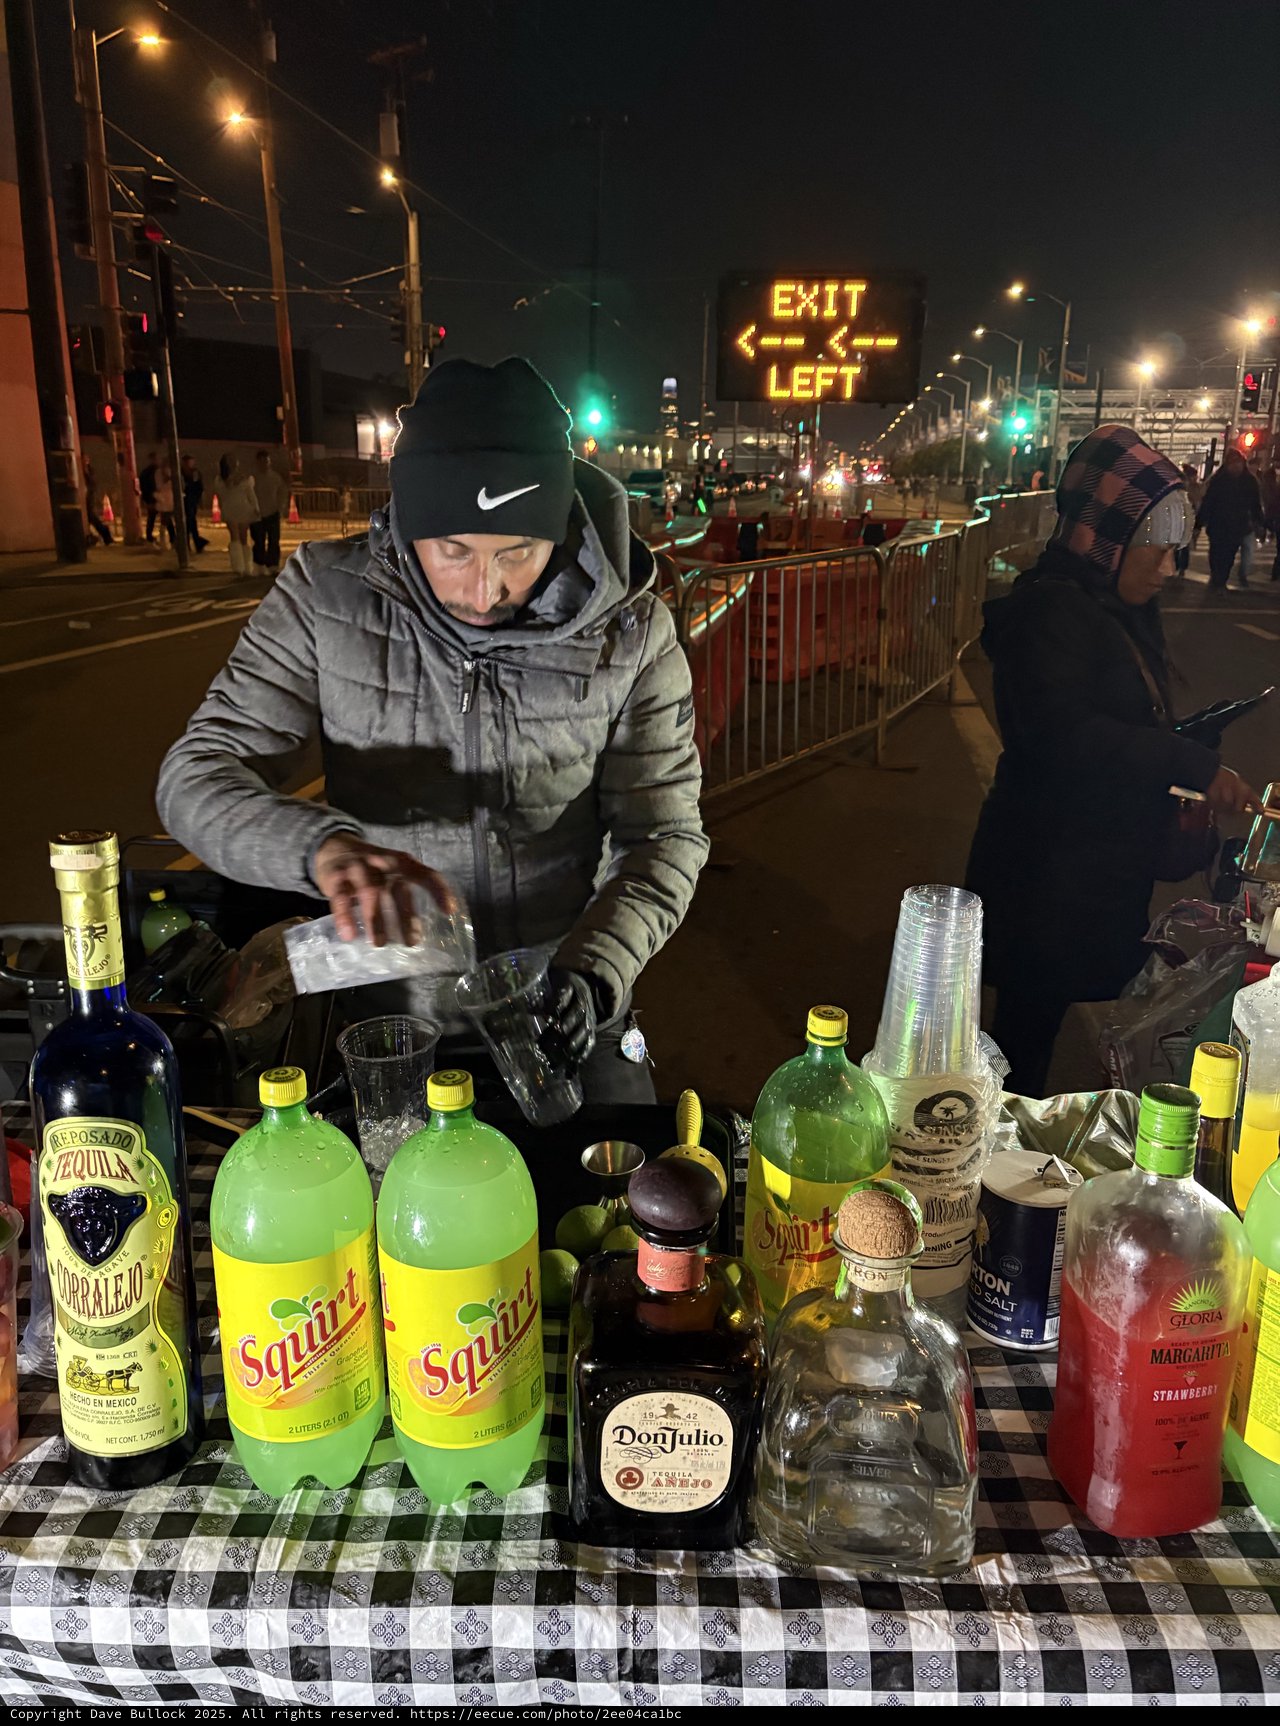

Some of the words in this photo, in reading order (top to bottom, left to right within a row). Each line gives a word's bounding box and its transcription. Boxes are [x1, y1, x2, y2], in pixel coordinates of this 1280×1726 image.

[773, 284, 866, 317] EXIT
[769, 365, 861, 399] LEFT
[53, 1130, 133, 1149] REPOSADO
[53, 1149, 139, 1185] TEQUILA
[758, 1206, 834, 1266] Squirt
[924, 1241, 952, 1251] RNING
[81, 1268, 93, 1278] DE
[98, 1250, 129, 1277] AGAVE
[57, 1258, 143, 1320] CORRALEJO
[972, 1262, 1011, 1296] RTON
[984, 1291, 1018, 1313] SALT
[1184, 1299, 1209, 1311] RANCHO
[240, 1267, 359, 1392] Squirt
[1170, 1311, 1223, 1328] GLORIA
[422, 1265, 535, 1397] Squirt
[303, 1358, 328, 1380] Thirst
[330, 1323, 361, 1357] Quencher
[1150, 1340, 1231, 1365] MARGARITA
[488, 1360, 510, 1382] Thirst
[70, 1391, 91, 1406] HECHO
[93, 1398, 103, 1407] EN
[106, 1397, 137, 1408] MEXICO
[1153, 1385, 1217, 1401] STRAWBERRY
[295, 1422, 322, 1434] LITERS
[323, 1417, 336, 1428] (2.1
[338, 1411, 349, 1421] QT)
[686, 1412, 698, 1420] 42
[118, 1435, 138, 1443] CONT.
[140, 1430, 157, 1441] 1,750
[157, 1426, 166, 1435] ml
[480, 1423, 505, 1437] LITERS
[852, 1464, 892, 1479] SILVER
[651, 1477, 713, 1489] AÑEJO
